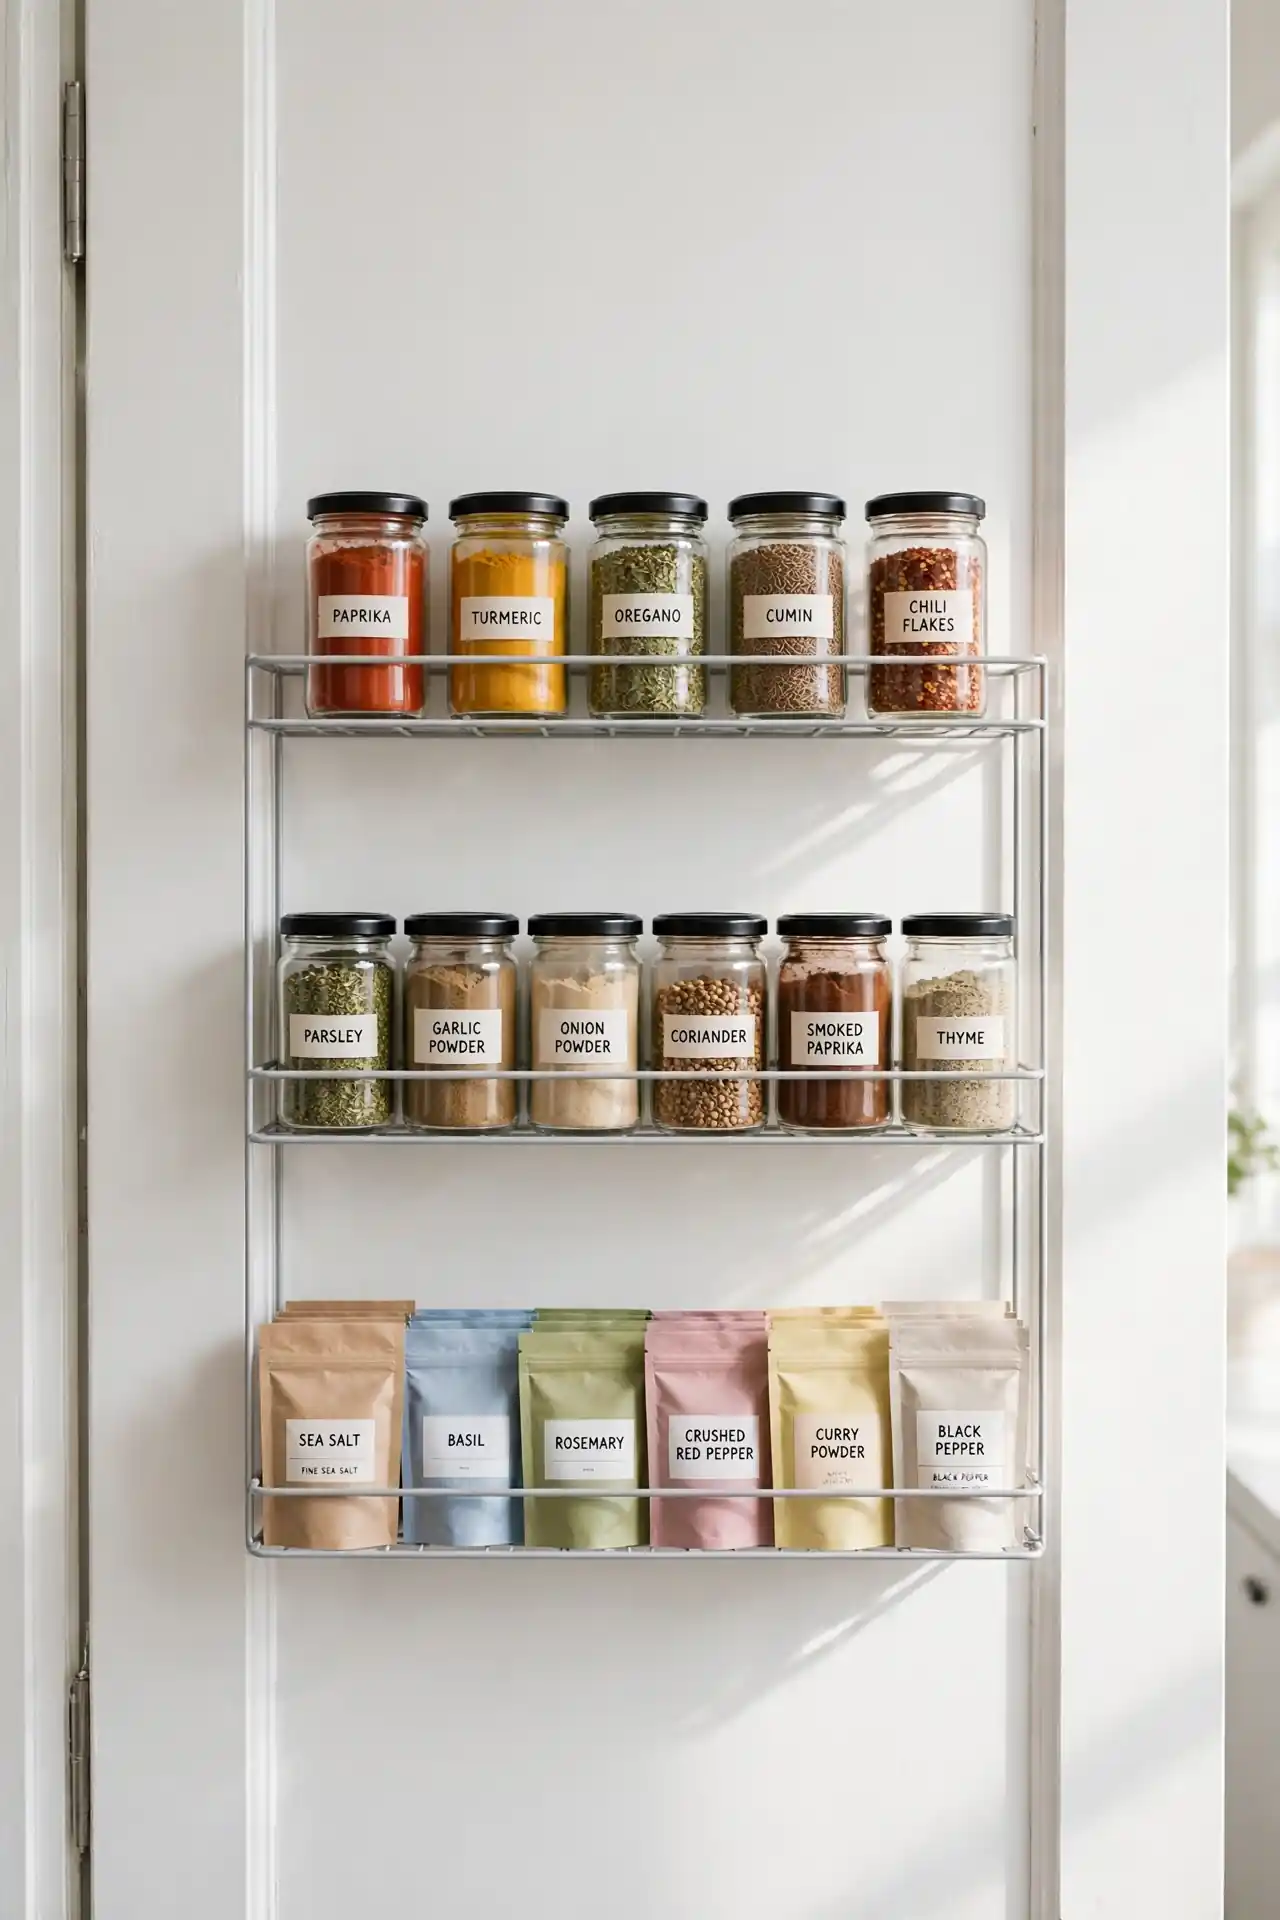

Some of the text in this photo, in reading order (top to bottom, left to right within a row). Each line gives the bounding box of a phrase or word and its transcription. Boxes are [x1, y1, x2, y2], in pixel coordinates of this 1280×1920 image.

[909, 599, 946, 614] CHILI
[332, 608, 391, 623] PAPRIKA
[471, 610, 542, 625] TURMERIC
[614, 608, 681, 623] OREGANO
[765, 608, 812, 623] CUMIN
[902, 617, 954, 632] FLAKES
[432, 1020, 481, 1036] GARLIC
[560, 1021, 605, 1036] ONION
[806, 1022, 863, 1037] SMOKED
[304, 1028, 363, 1044] PARSLEY
[670, 1028, 747, 1044] CORIANDER
[936, 1030, 985, 1045] THYME
[429, 1039, 485, 1054] POWDER
[555, 1039, 611, 1054] POWDER
[807, 1040, 864, 1055] PAPRIKA
[685, 1429, 746, 1443] CRUSHED
[815, 1428, 860, 1441] CURRY
[938, 1424, 981, 1438] BLACK
[299, 1433, 361, 1447] SEA SALT
[448, 1433, 485, 1447] BASIL
[555, 1436, 625, 1450] ROSEMARY
[676, 1447, 754, 1460] RED PEPPER
[810, 1445, 865, 1459] POWDER
[935, 1442, 985, 1456] PEPPER
[301, 1466, 358, 1475] FINE SEA SALT
